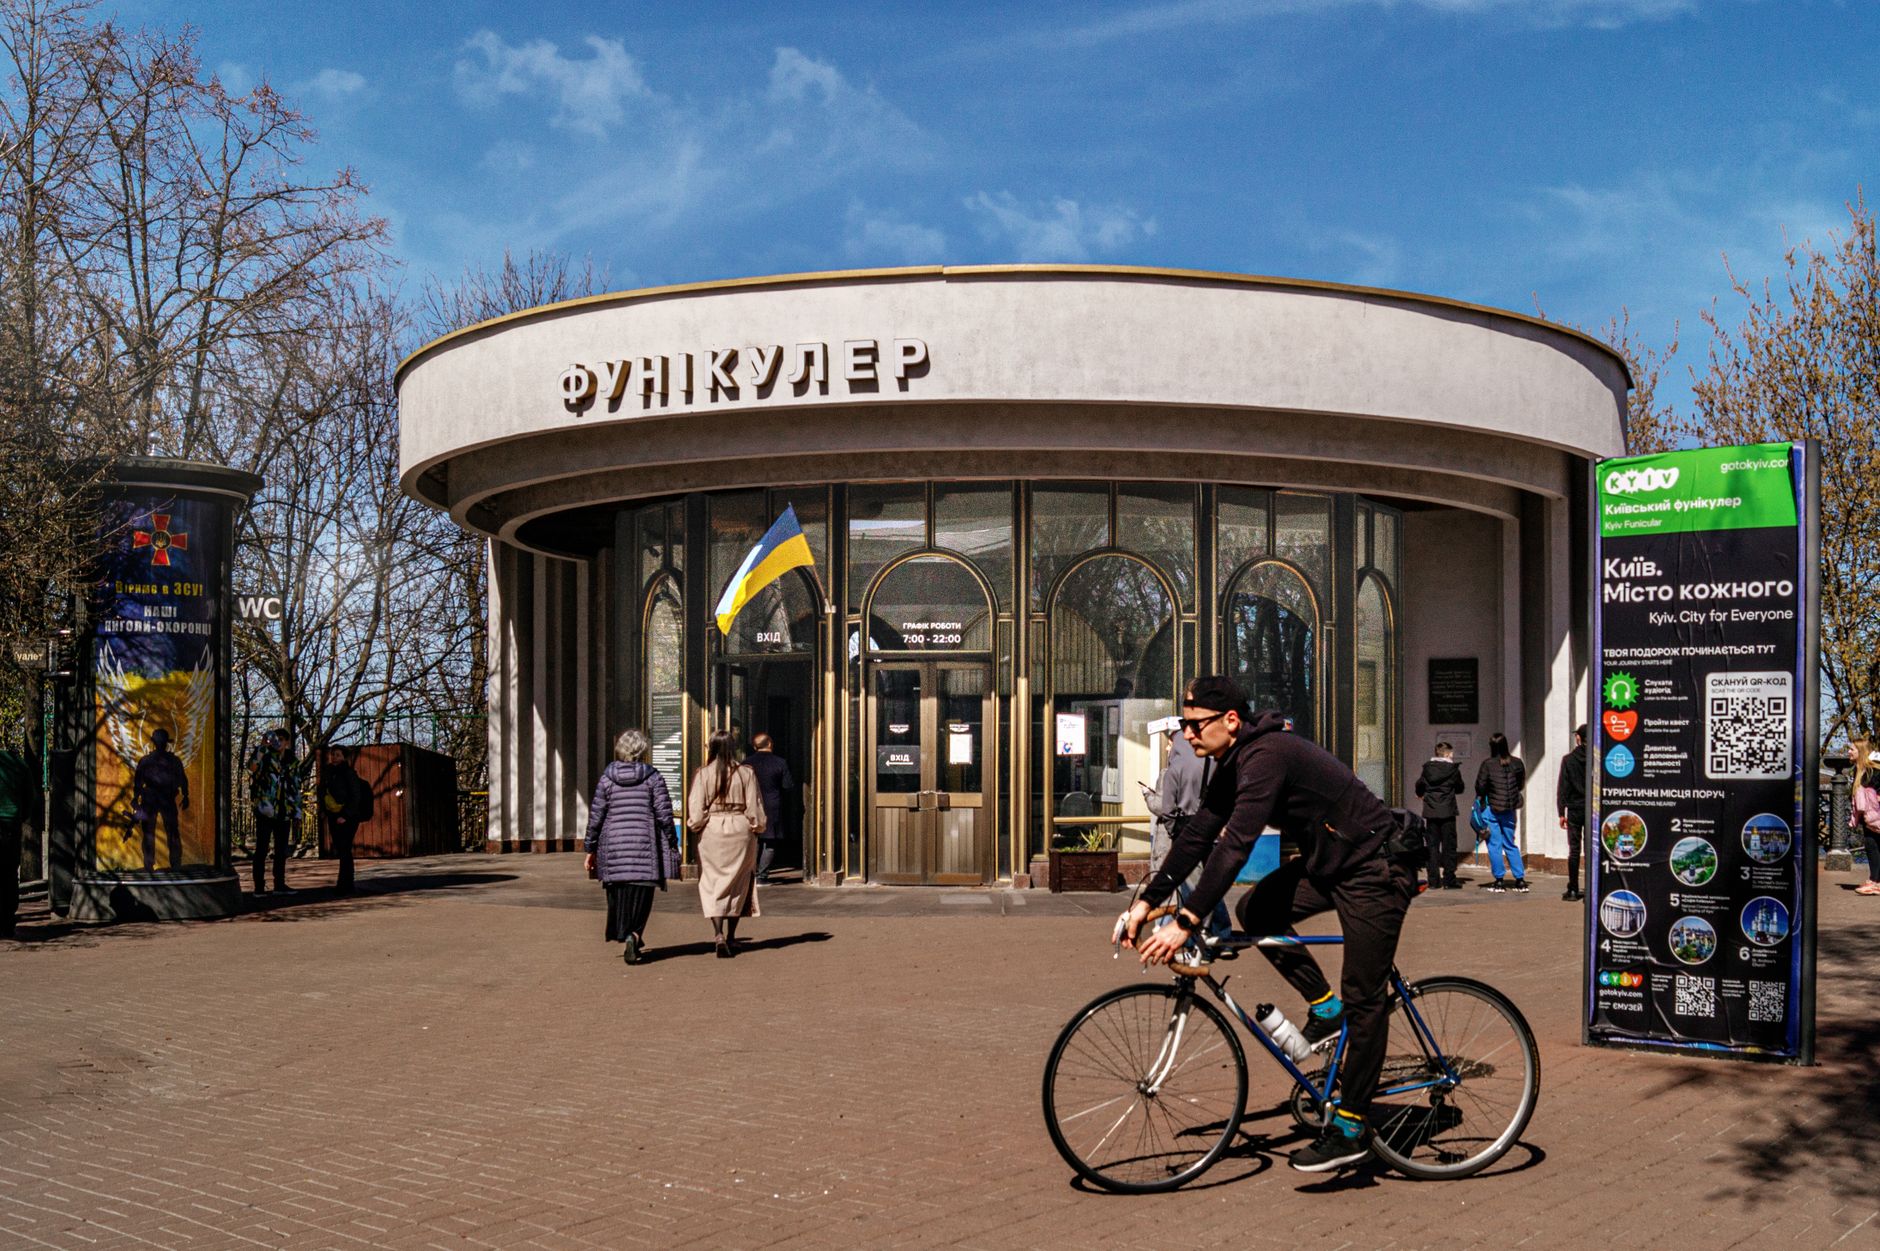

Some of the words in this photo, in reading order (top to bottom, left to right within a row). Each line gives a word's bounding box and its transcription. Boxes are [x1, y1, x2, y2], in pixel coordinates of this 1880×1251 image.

[556, 337, 930, 408] ФУНІКУЛЕР
[1605, 499, 1671, 515] Київський
[1674, 497, 1742, 512] фунікулер
[1605, 521, 1623, 531] Kyiv
[1624, 518, 1663, 529] Funicular
[1604, 556, 1663, 579] Київ.
[174, 581, 204, 597] ЗСУ!
[1604, 582, 1674, 603] Місто
[1680, 580, 1794, 600] кожного
[144, 605, 177, 618] НАШІ
[238, 597, 281, 618] WC
[1649, 611, 1677, 626] Kyiv.
[1679, 610, 1706, 625] City
[1709, 609, 1728, 622] for
[1731, 609, 1794, 624] Everyone
[902, 622, 929, 630] ГРАФІК
[931, 622, 962, 630] РОБОТИ
[756, 632, 781, 643] ВХІД
[903, 634, 925, 644] 7:00
[933, 634, 961, 644] 22:00
[1603, 648, 1629, 658] ТВОЯ
[1630, 647, 1680, 657] ПОДОРОЖ
[1681, 645, 1755, 656] ПОЧИНАЄТЬСЯ
[1757, 645, 1776, 654] ТУТ
[1711, 676, 1748, 687] СКАНУЙ
[1750, 677, 1787, 687] QR-КОД
[1643, 718, 1669, 727] Пройти
[890, 754, 910, 762] ВХІД
[1602, 788, 1659, 797] ТУРИСТИЧНІ
[1660, 789, 1691, 799] МІСЦЯ
[1692, 789, 1725, 799] ПОРУЧ
[1670, 818, 1681, 832] 2
[1601, 860, 1610, 874] 1
[1740, 866, 1750, 880] 3
[1669, 893, 1680, 907] 5
[1601, 939, 1611, 953] 4
[1739, 946, 1750, 961] 6
[1599, 989, 1643, 998] gotokyiv.com
